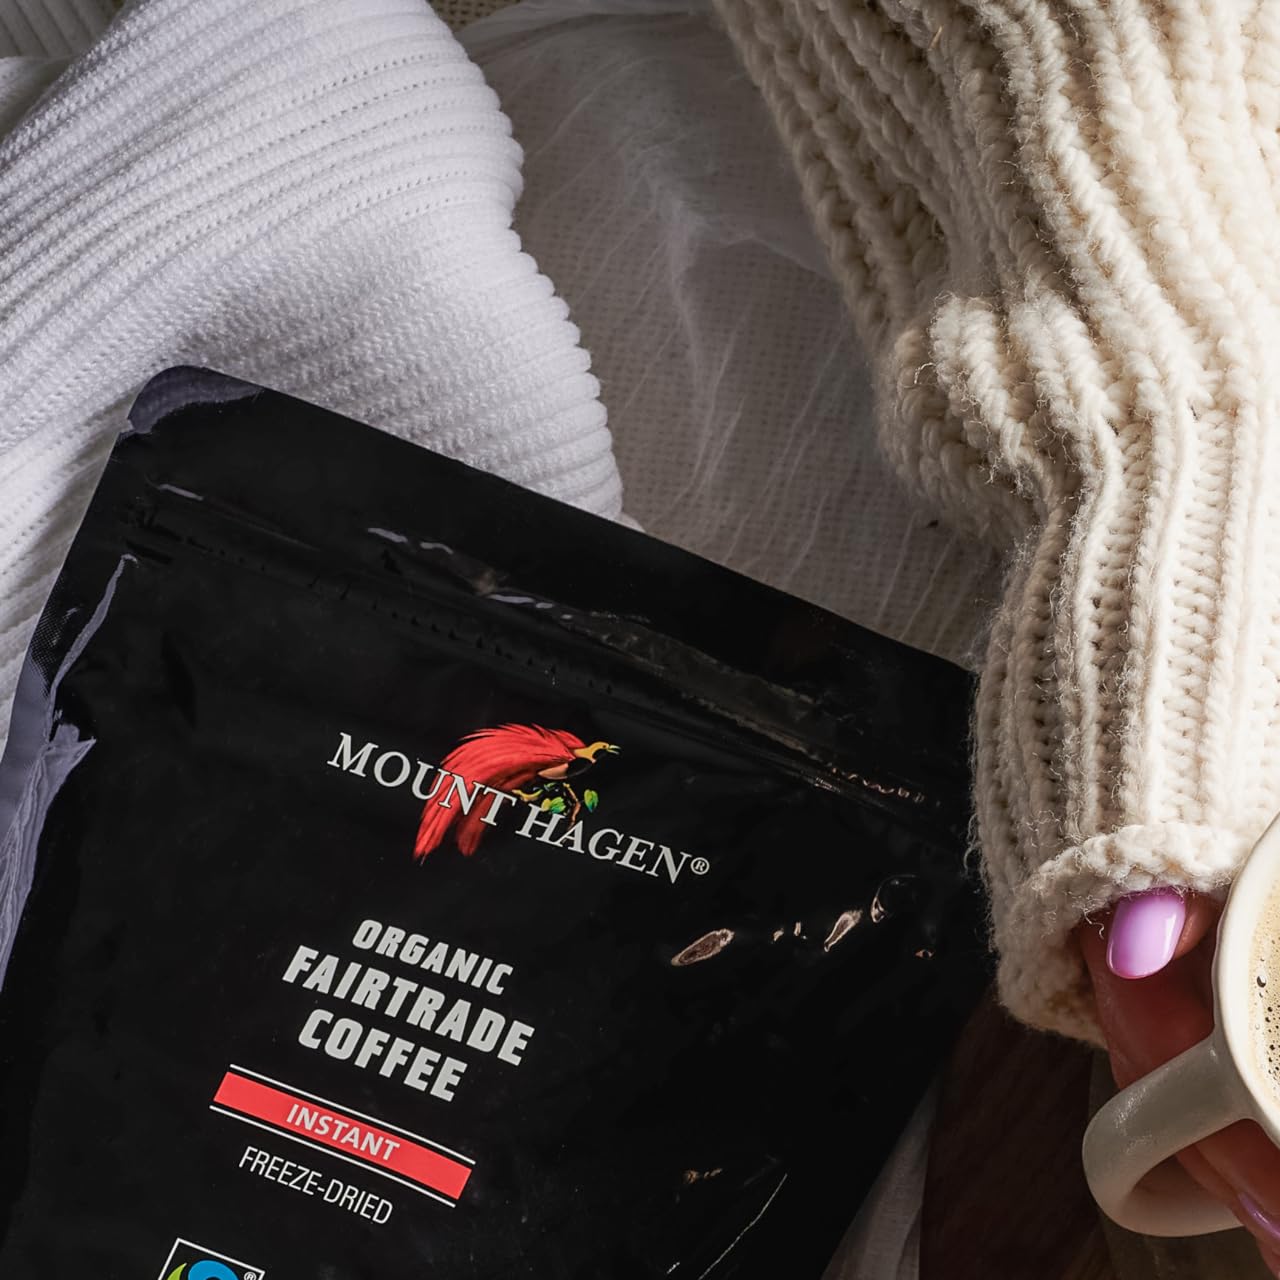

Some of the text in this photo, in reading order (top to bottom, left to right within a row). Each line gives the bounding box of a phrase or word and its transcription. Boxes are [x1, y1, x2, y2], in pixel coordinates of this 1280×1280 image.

[327, 733, 517, 826] MOUNT
[352, 919, 514, 996] ORGANIC
[282, 945, 536, 1066] FAIRTRADE
[298, 1009, 468, 1102] COFFEE
[286, 1103, 401, 1162] INSTANT
[238, 1146, 394, 1225] FREEZE-DRIED
